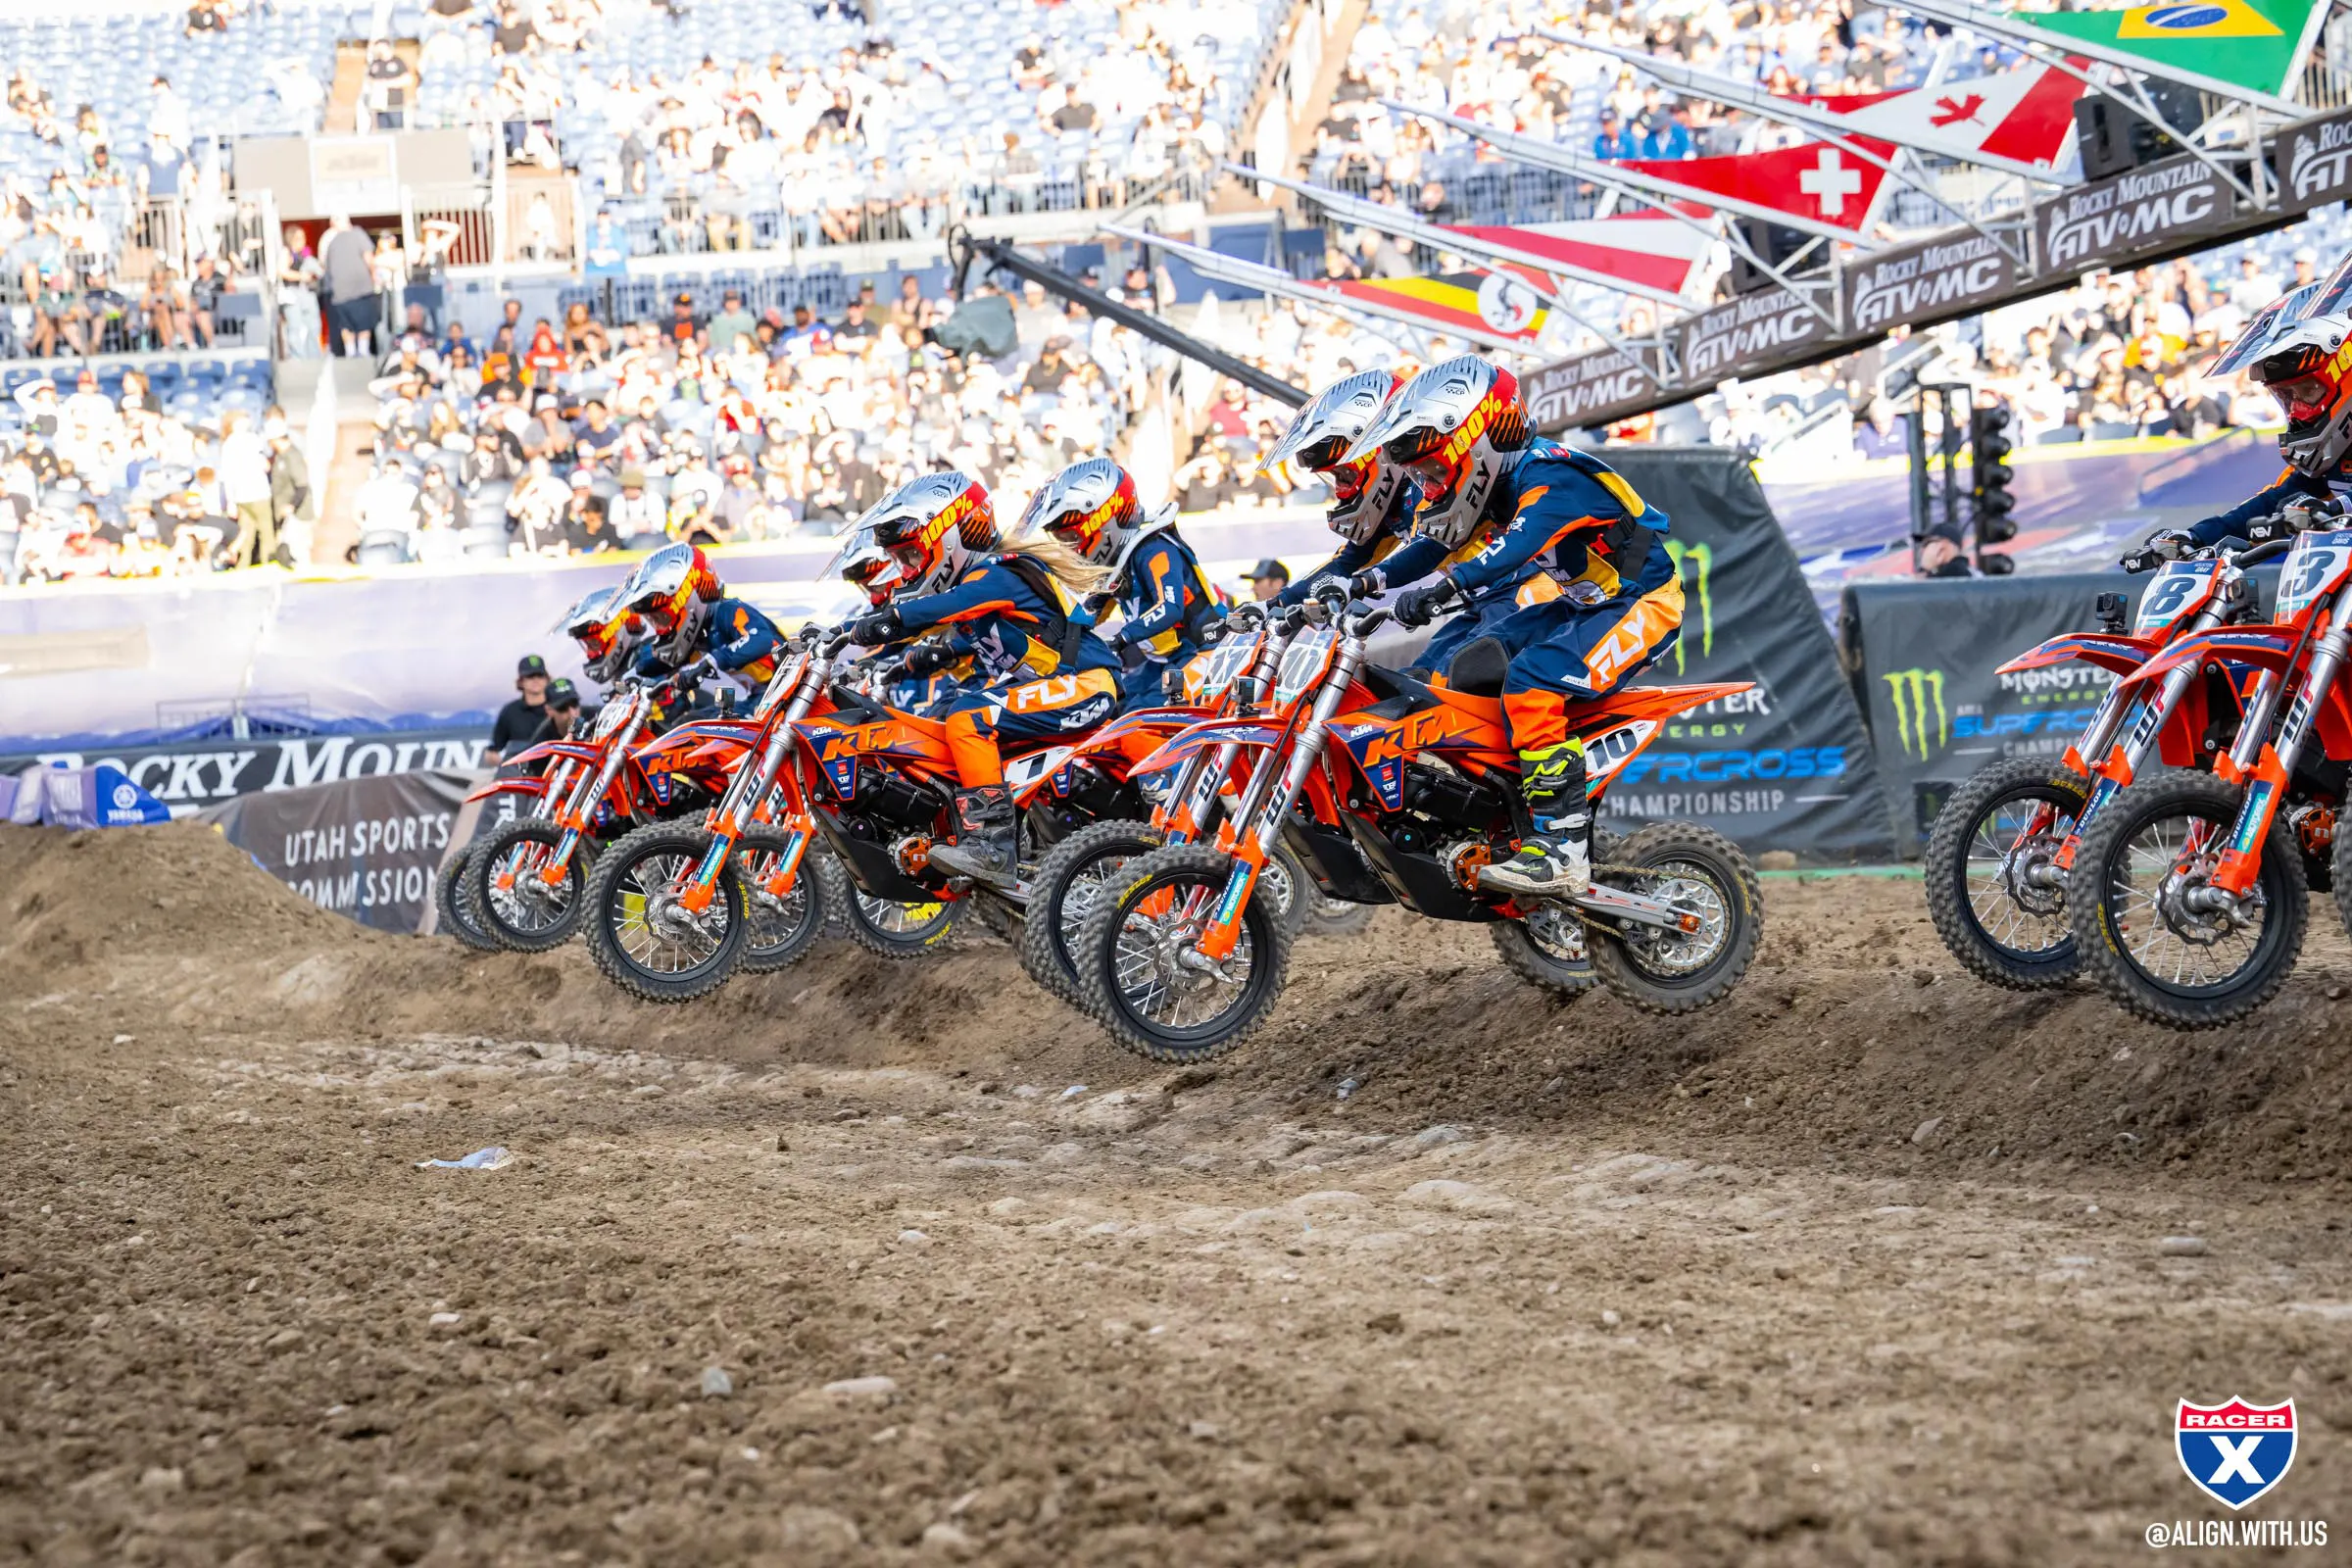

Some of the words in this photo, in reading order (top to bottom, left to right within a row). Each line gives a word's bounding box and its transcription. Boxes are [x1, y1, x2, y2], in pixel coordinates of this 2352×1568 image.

[2068, 189, 2113, 222] ROCKY
[2115, 160, 2212, 205] MOUNTAIN
[1874, 256, 1920, 288] ROCKY
[1443, 391, 1502, 466] 100%
[1372, 466, 1395, 511] FLY
[1466, 460, 1491, 509] FLY
[920, 494, 973, 550] 100%
[1080, 490, 1124, 537] 100%
[1477, 536, 1506, 565] FLY
[670, 567, 701, 614] 100%
[932, 556, 955, 594] FLY
[2281, 551, 2336, 598] 3
[1143, 604, 1166, 627] FLY
[2141, 577, 2197, 615] 8
[1589, 610, 1645, 685] FLY
[1017, 674, 1077, 710] FLY
[811, 726, 833, 736] KTM
[1350, 724, 1372, 737] KTM
[1587, 728, 1638, 769] 10
[1621, 746, 1846, 784] ERCROSS
[1595, 789, 1785, 817] CHAMPIONSHIP
[2079, 788, 2102, 828] DUNLOP
[285, 824, 346, 866] UTAH
[351, 812, 451, 857] SPORTS
